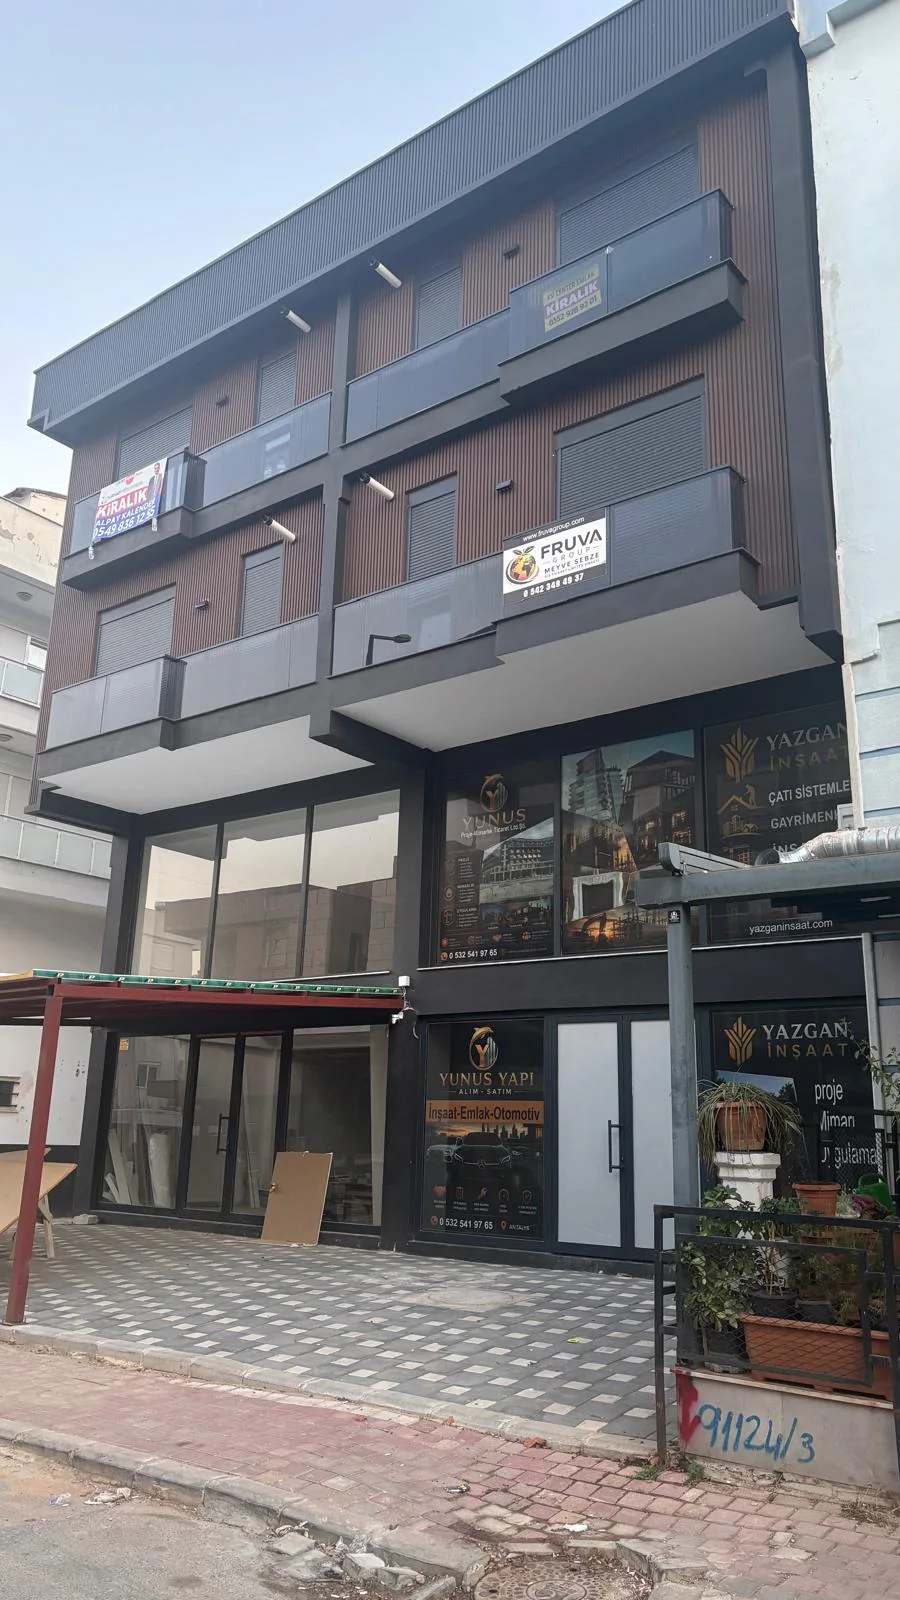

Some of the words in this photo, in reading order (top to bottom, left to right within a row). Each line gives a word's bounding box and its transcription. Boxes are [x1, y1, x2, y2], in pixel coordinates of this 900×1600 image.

[96, 488, 147, 517] KİRALIK
[96, 514, 120, 526] ALPAY
[523, 516, 585, 542] www.fruvagroup.com
[541, 529, 602, 559] FRUVA
[544, 562, 571, 574] MEYVE
[574, 552, 600, 564] SEBZE
[552, 547, 590, 563] GROUP
[524, 590, 528, 598] 0
[530, 586, 544, 596] 542
[546, 580, 560, 590] 349
[563, 576, 572, 585] 49
[574, 573, 584, 582] 37
[768, 790, 792, 806] ÇATI
[462, 808, 526, 831] YUNUS
[770, 810, 838, 829] GAYRİMEN
[749, 920, 833, 935] yazganinsaat.com
[763, 1022, 848, 1040] YAZGAN
[768, 1040, 848, 1060] İNŞAAT
[440, 1072, 492, 1086] YUNUS
[498, 1072, 534, 1086] YAPI
[814, 1078, 843, 1105] proje
[460, 1220, 472, 1228] 541
[473, 1220, 482, 1229] 97
[484, 1221, 493, 1229] 65
